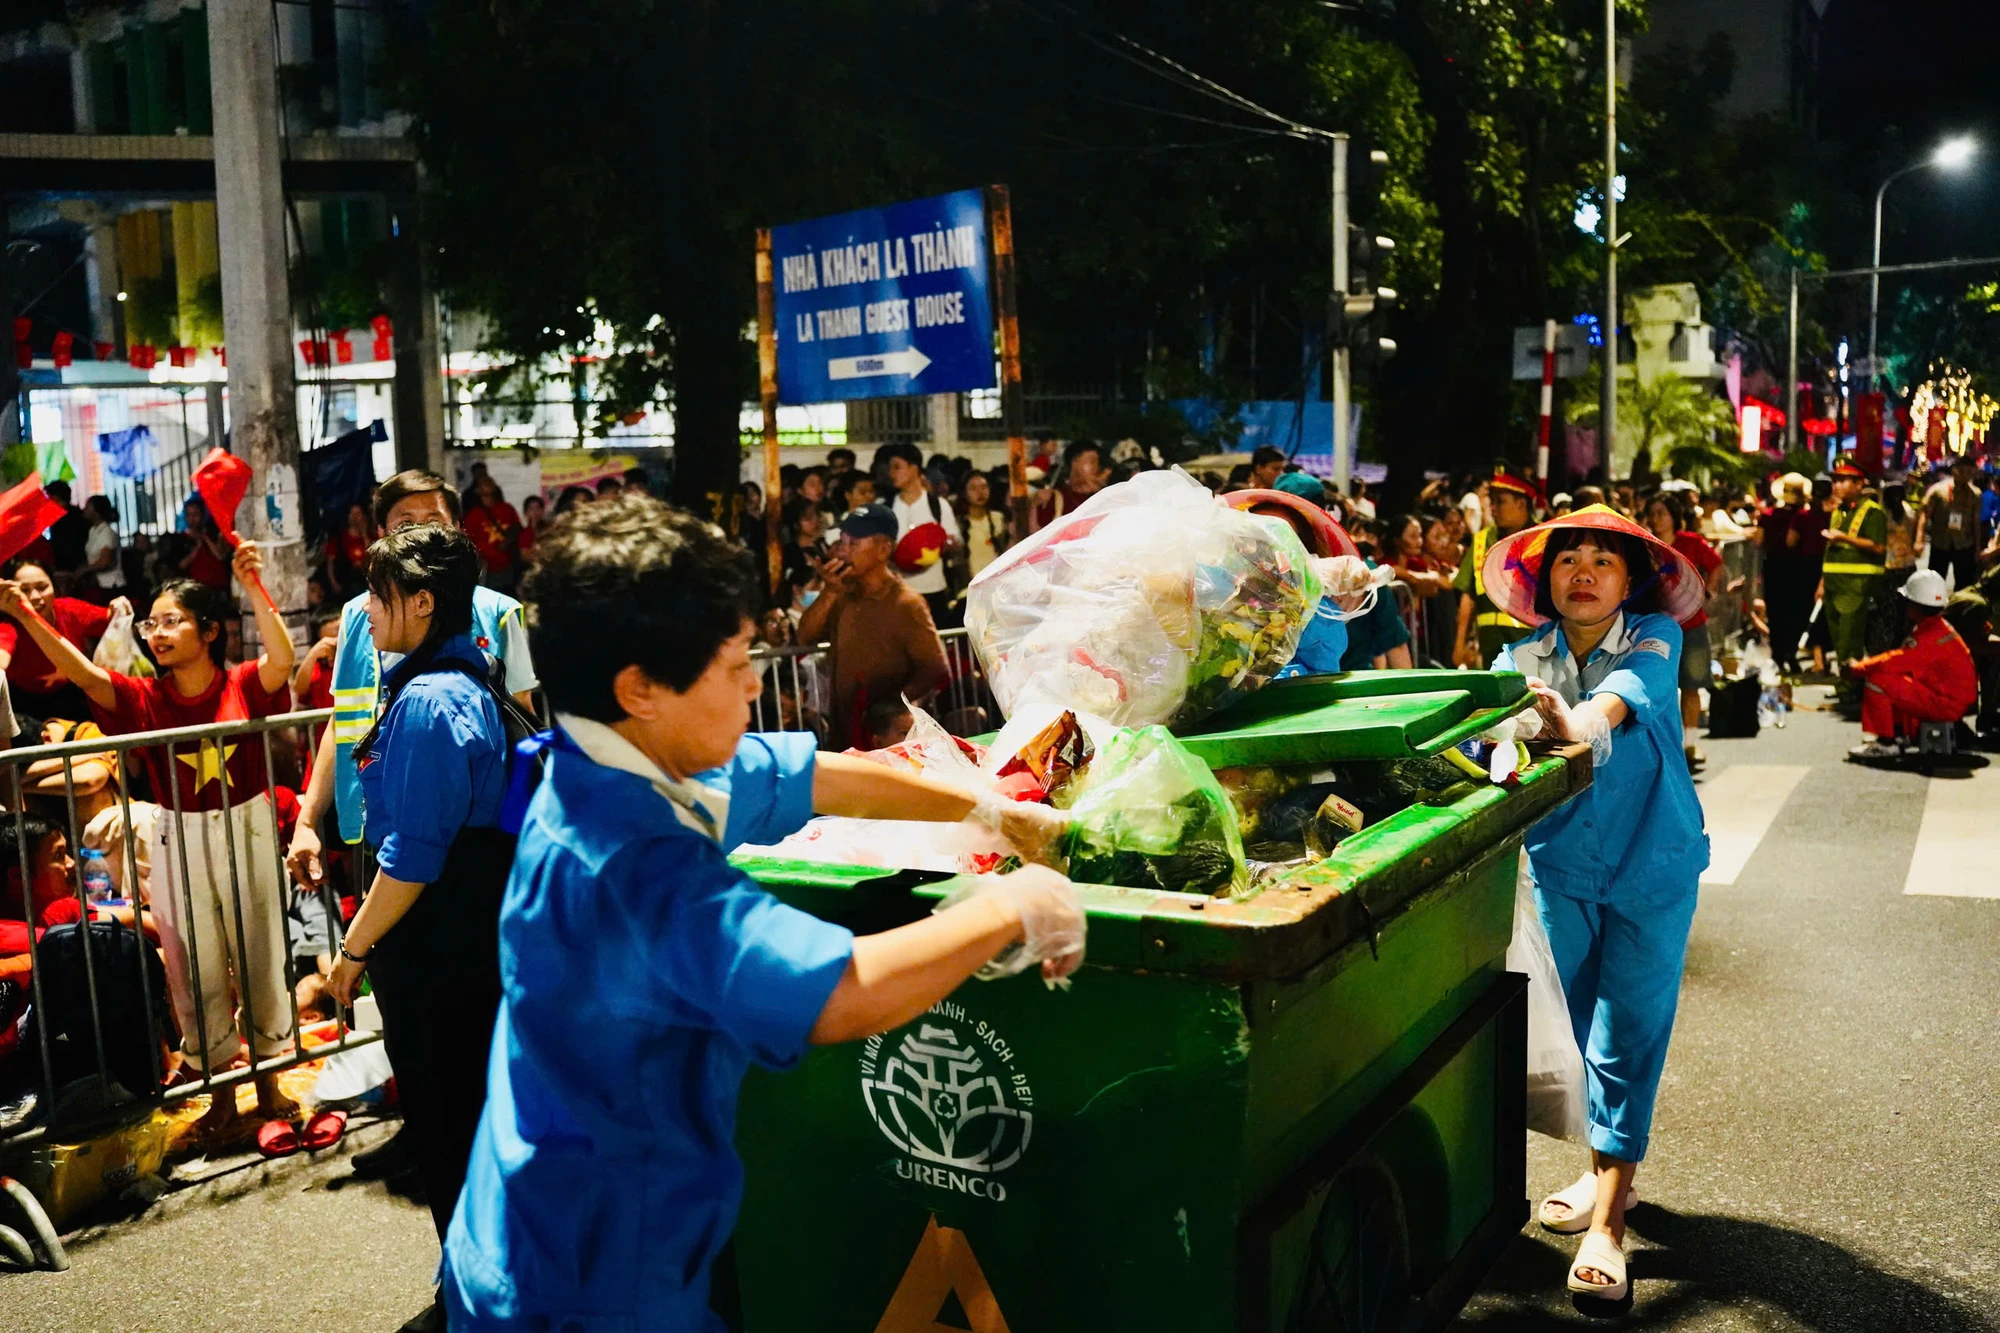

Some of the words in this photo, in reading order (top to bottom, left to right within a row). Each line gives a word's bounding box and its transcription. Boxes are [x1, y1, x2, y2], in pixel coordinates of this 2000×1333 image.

[783, 244, 818, 293] NHÀ
[822, 235, 880, 287] KHÁCH
[884, 238, 909, 279] LA
[911, 221, 975, 274] THÀNH
[797, 312, 814, 343] LA
[817, 306, 861, 339] THANH
[865, 299, 909, 334] GUEST
[915, 292, 965, 328] HOUSE
[975, 1020, 1014, 1063] SẠCH
[896, 1159, 1006, 1201] URENCO
